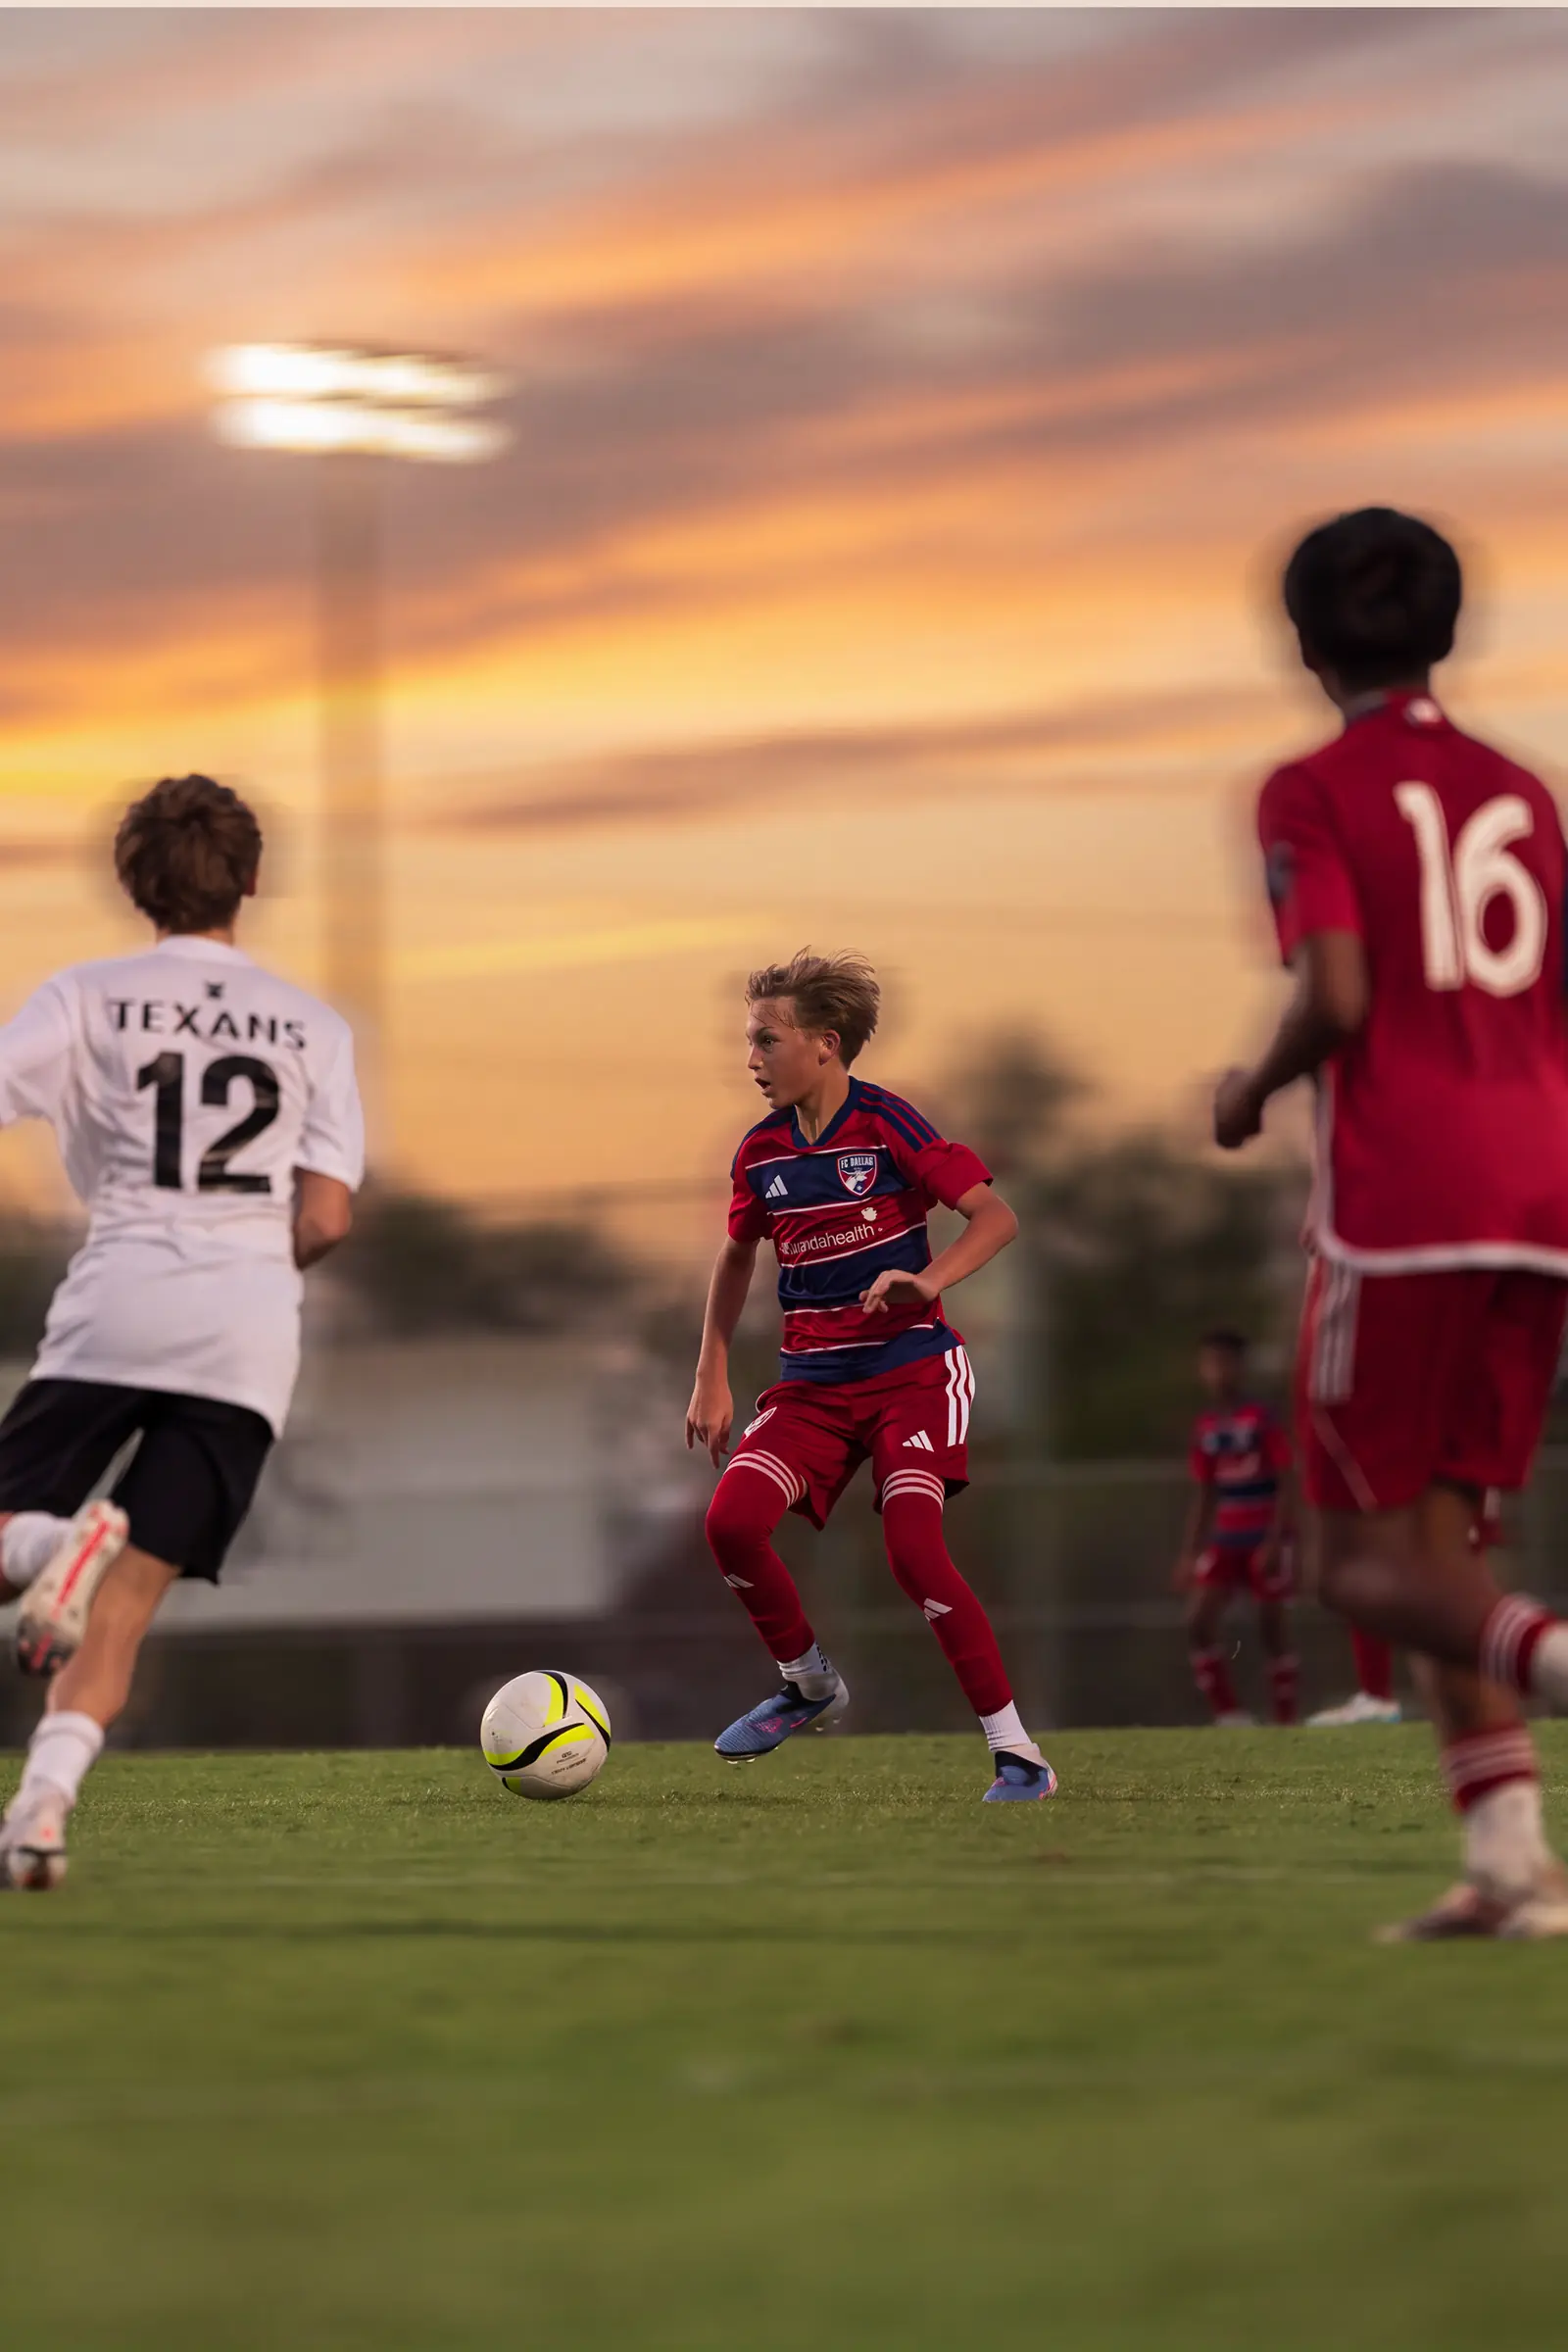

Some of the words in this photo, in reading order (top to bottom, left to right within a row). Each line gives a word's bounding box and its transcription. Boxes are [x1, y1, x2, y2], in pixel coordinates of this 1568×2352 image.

[1394, 781, 1548, 998] 16
[109, 999, 306, 1050] TEXANS
[137, 1052, 279, 1193] 12
[841, 1158, 849, 1169] FC
[850, 1156, 874, 1167] DALLAS
